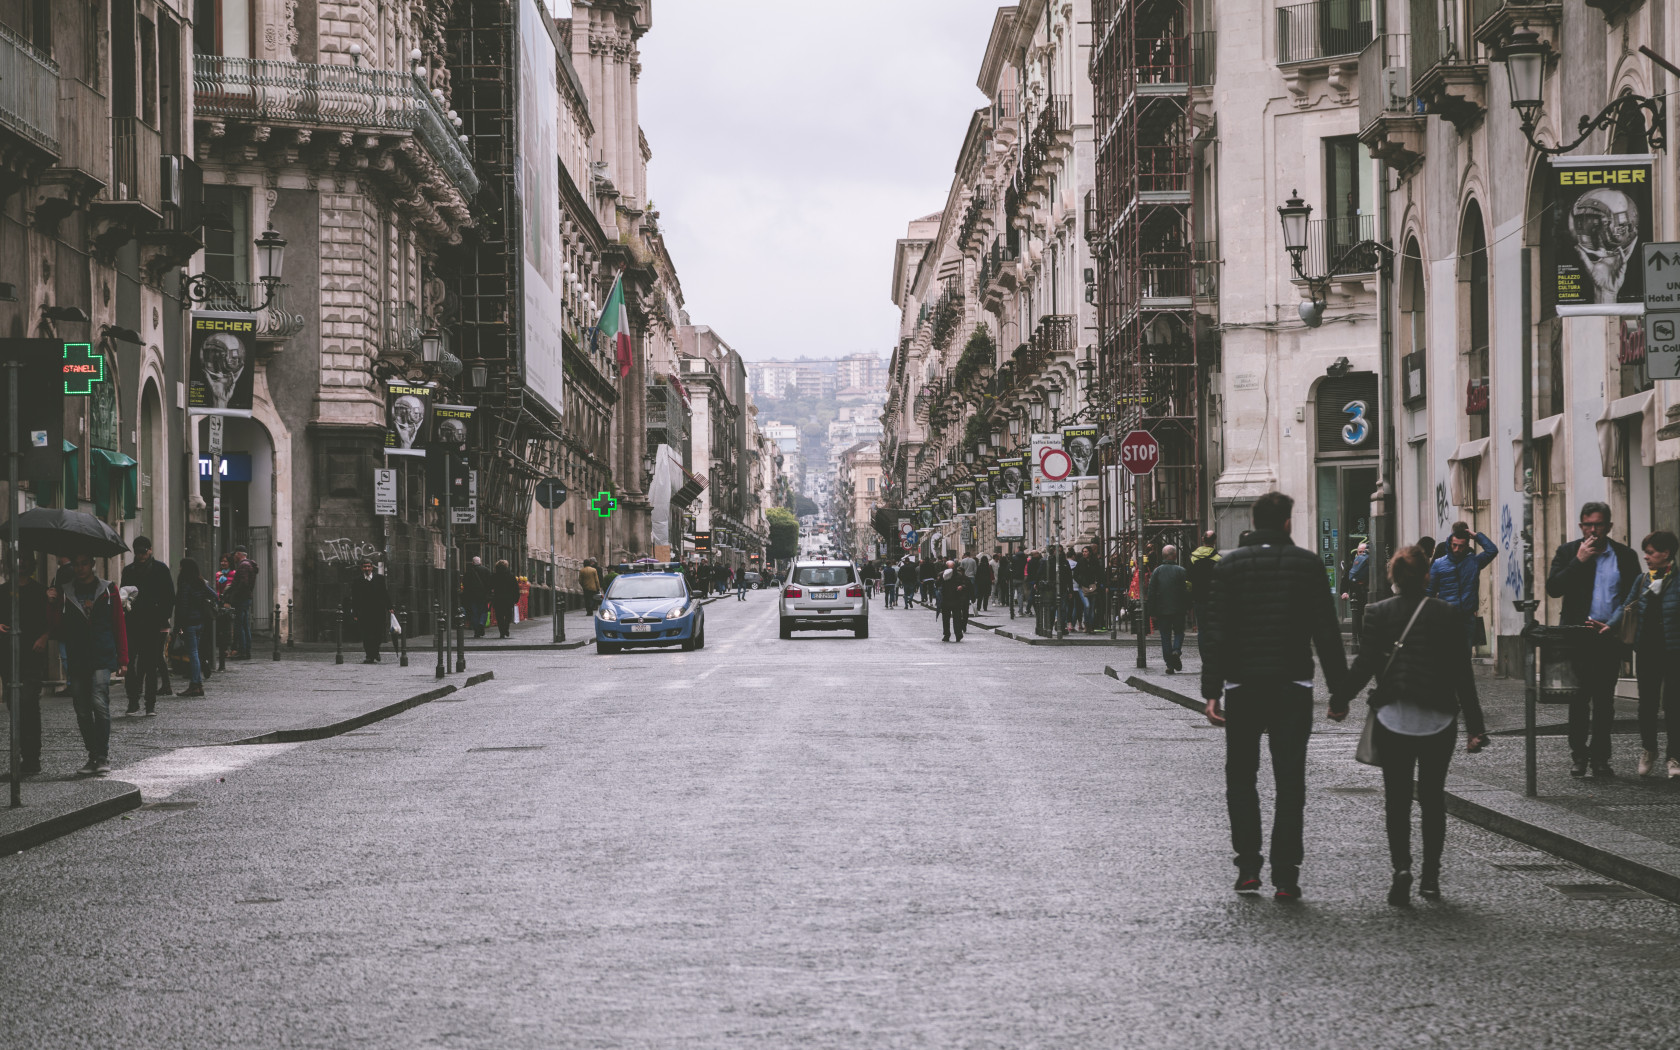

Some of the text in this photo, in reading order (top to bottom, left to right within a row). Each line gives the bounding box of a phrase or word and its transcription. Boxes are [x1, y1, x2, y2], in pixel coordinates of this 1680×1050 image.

[1560, 169, 1646, 185] ESCHER
[1648, 294, 1673, 303] Hotel
[196, 320, 252, 332] ESCHER
[1648, 345, 1659, 353] La
[389, 386, 430, 395] ESCHER
[436, 410, 472, 418] ESCHER
[1341, 400, 1370, 445] 3
[1123, 444, 1156, 462] STOP
[199, 459, 228, 476] TIM
